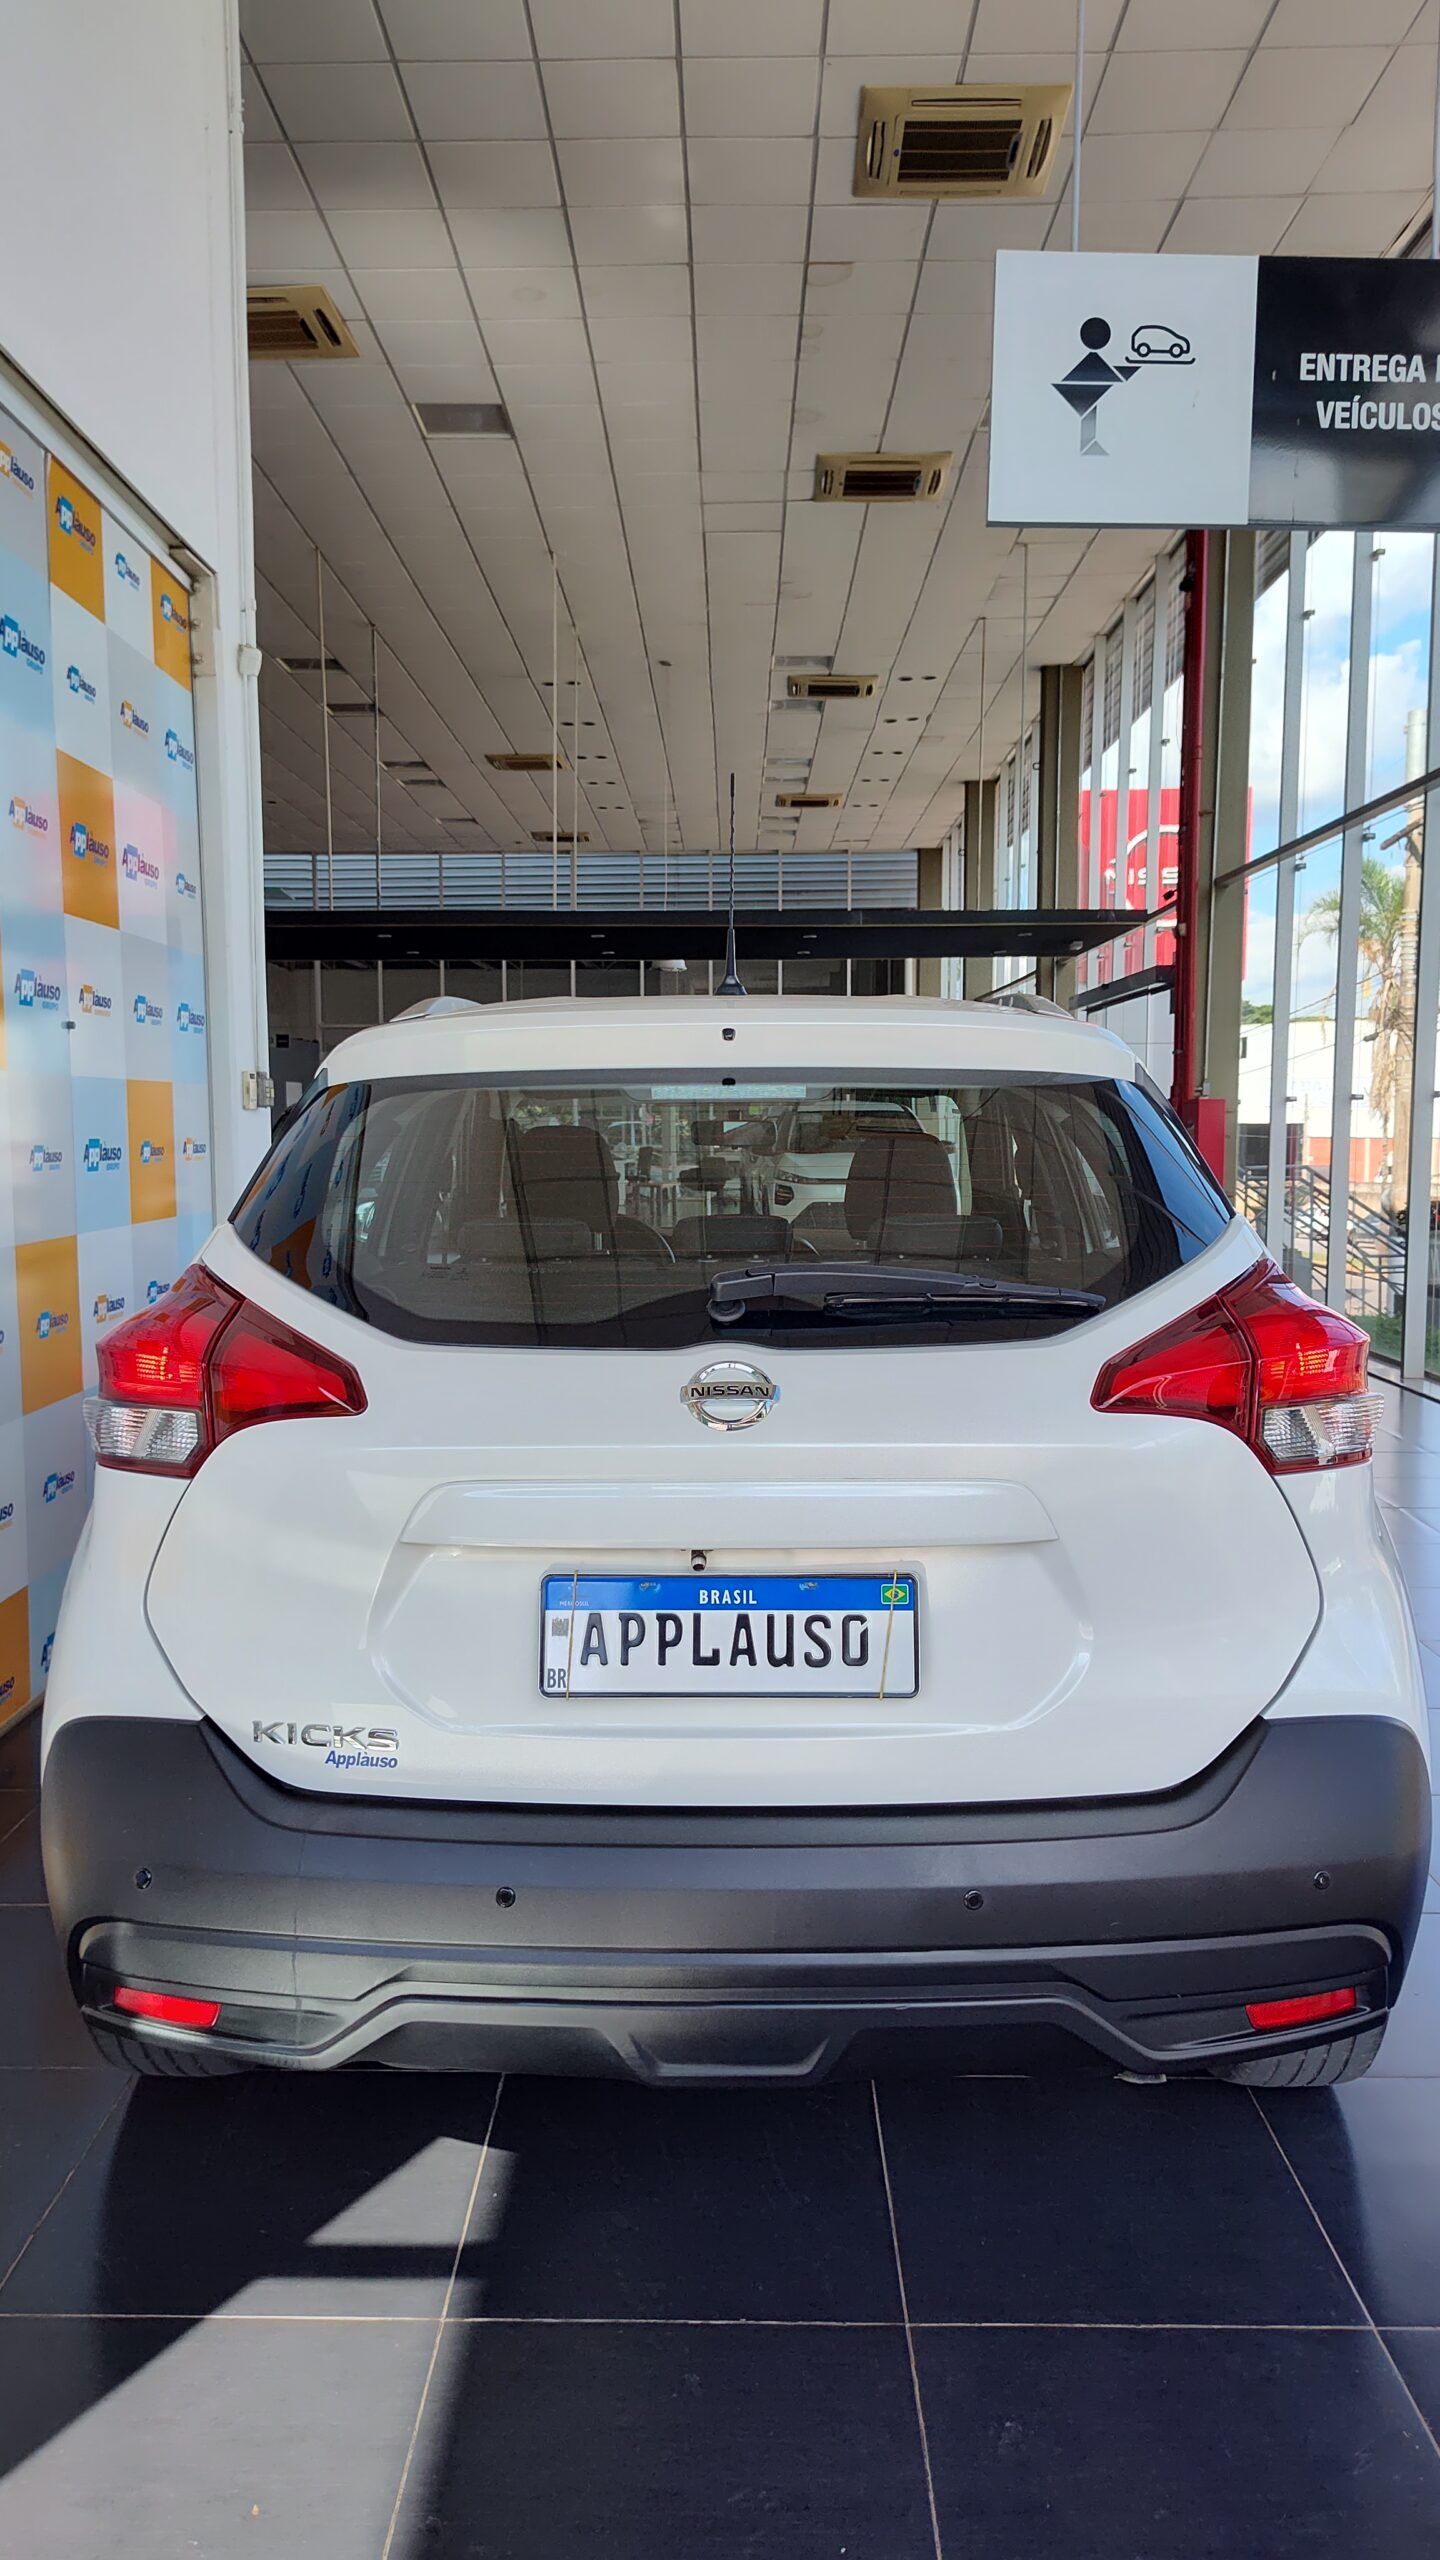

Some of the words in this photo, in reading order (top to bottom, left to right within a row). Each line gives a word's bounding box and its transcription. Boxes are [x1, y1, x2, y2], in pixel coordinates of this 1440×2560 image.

[1300, 353, 1426, 382] ENTREGA
[690, 1385, 769, 1397] NISSAN
[699, 1589, 757, 1604] BRASIL
[580, 1612, 869, 1667] APPLAUSO
[547, 1668, 567, 1688] BR
[252, 1720, 399, 1751] KICKS
[324, 1750, 398, 1769] Applàuso
